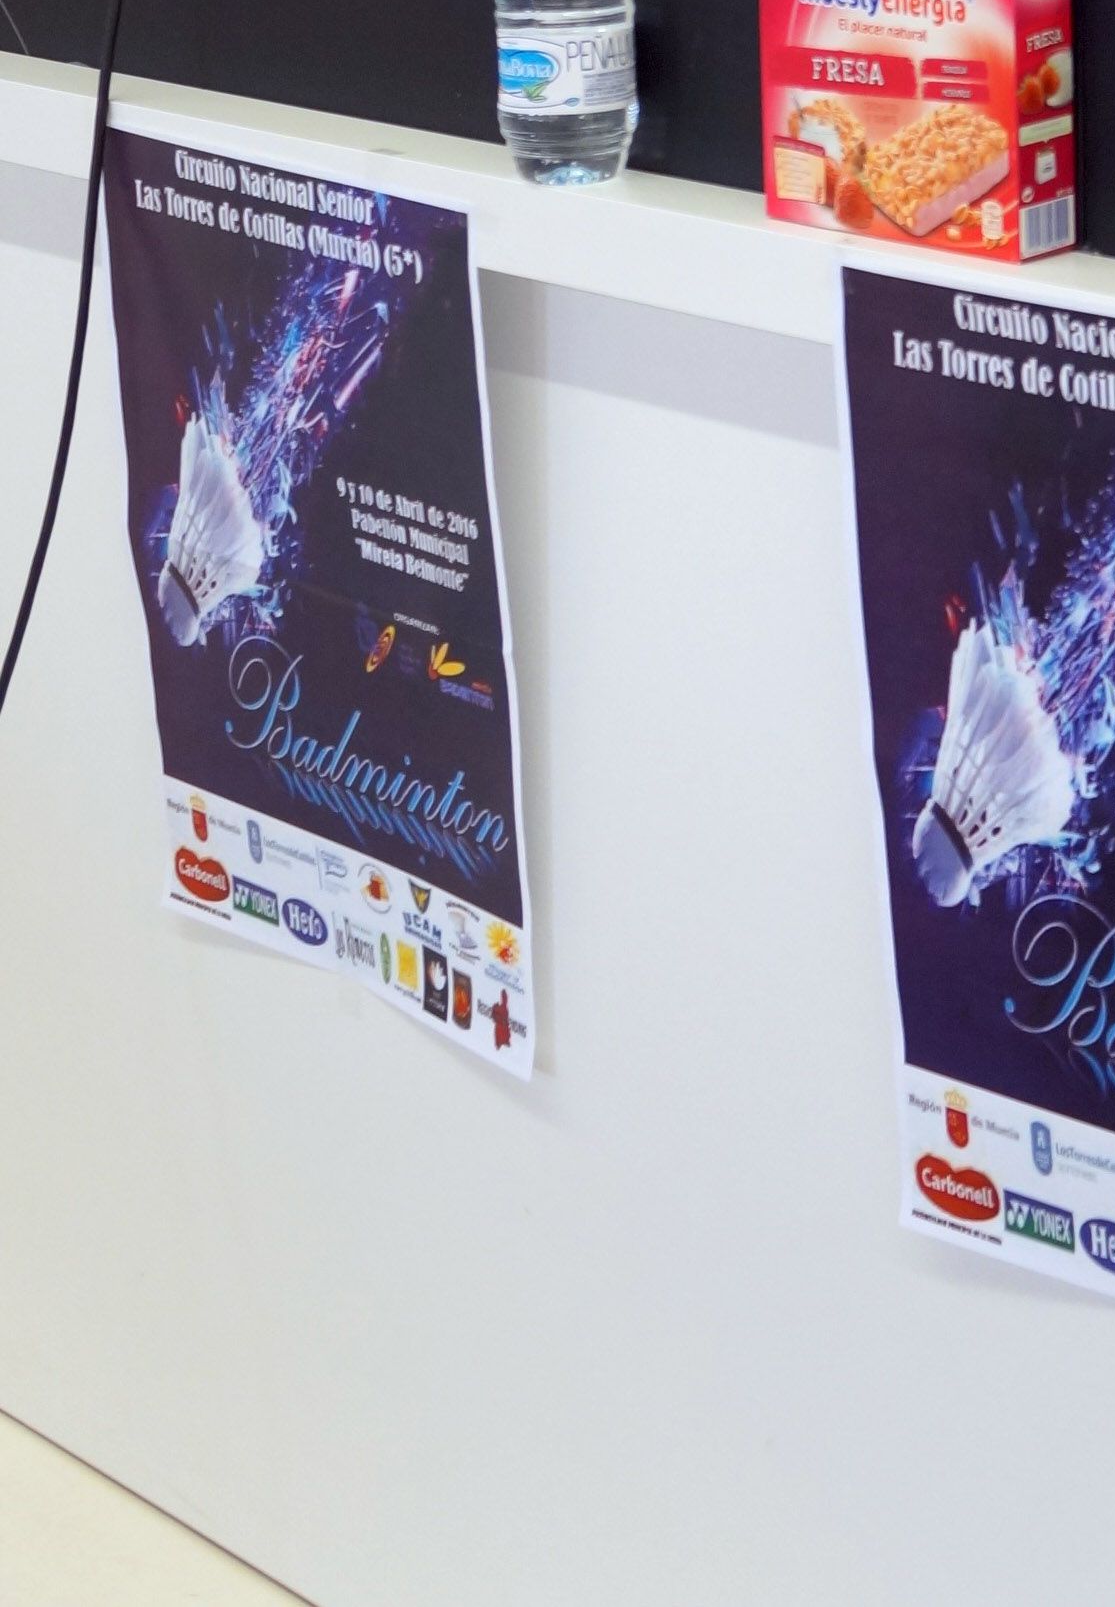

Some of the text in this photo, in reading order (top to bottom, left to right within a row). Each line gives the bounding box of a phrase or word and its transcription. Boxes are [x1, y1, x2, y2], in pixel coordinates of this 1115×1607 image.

[811, 57, 885, 86] FRESA
[174, 149, 375, 226] Circuito Nacional Senior
[134, 179, 162, 213] Las
[164, 185, 215, 227] Torres
[218, 203, 240, 234] de
[243, 208, 305, 251] Cotillas
[308, 224, 381, 274] (Murcia)
[953, 294, 1047, 345] Circuito
[893, 330, 933, 373] Las
[938, 340, 1014, 391] Torres
[1022, 357, 1054, 397] de
[336, 477, 478, 540] 9 y 10 de Abril de 2016
[351, 508, 470, 566] Pabellón Municipal
[225, 635, 509, 853] Badminton
[178, 858, 227, 891] Carbonell
[250, 891, 278, 920] YONEX
[287, 902, 324, 939] Hero
[402, 911, 442, 941] UCAM
[922, 1167, 995, 1208] Carbonell
[1031, 1206, 1072, 1244] YONEX
